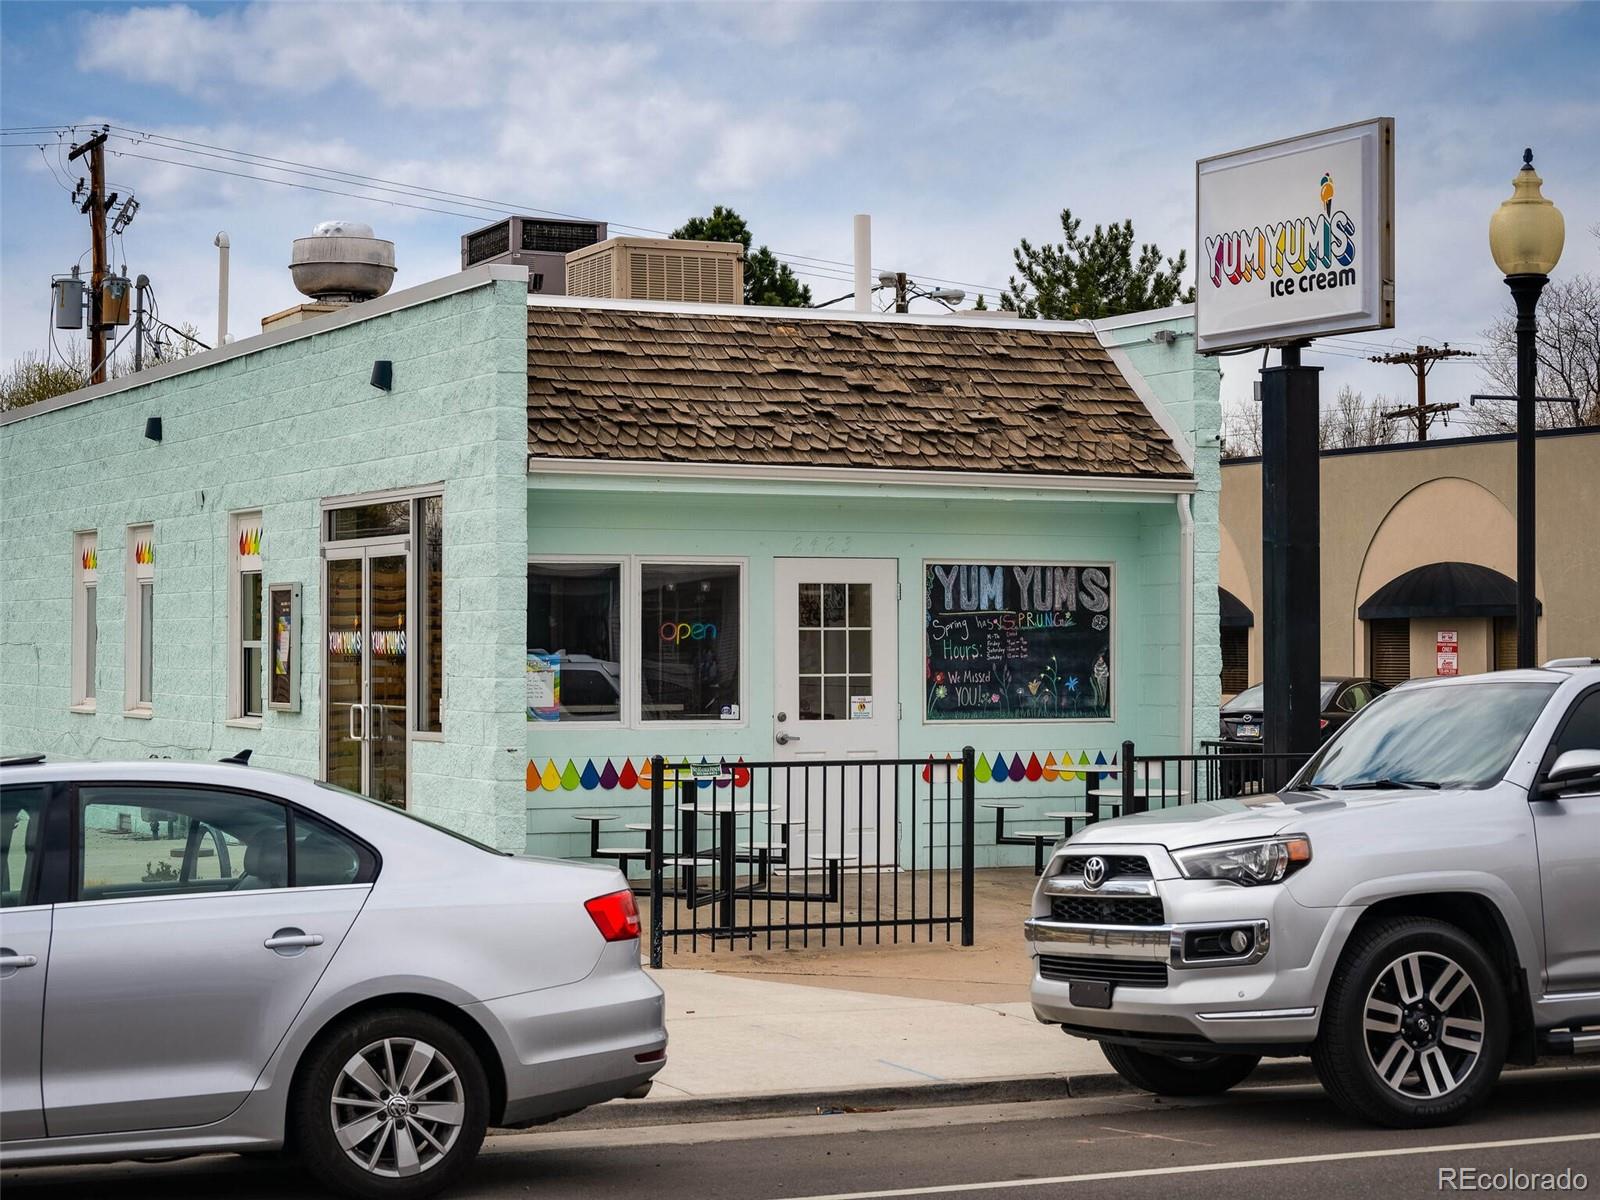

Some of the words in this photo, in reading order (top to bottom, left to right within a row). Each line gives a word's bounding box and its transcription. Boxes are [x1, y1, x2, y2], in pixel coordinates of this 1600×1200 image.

[1299, 268, 1356, 292] cream
[934, 566, 1004, 611] YUM
[1013, 566, 1109, 613] YUMS
[660, 622, 717, 645] open
[932, 618, 969, 641] Spring
[943, 639, 983, 660] Hours:
[947, 672, 961, 684] We
[963, 670, 991, 683] Missed
